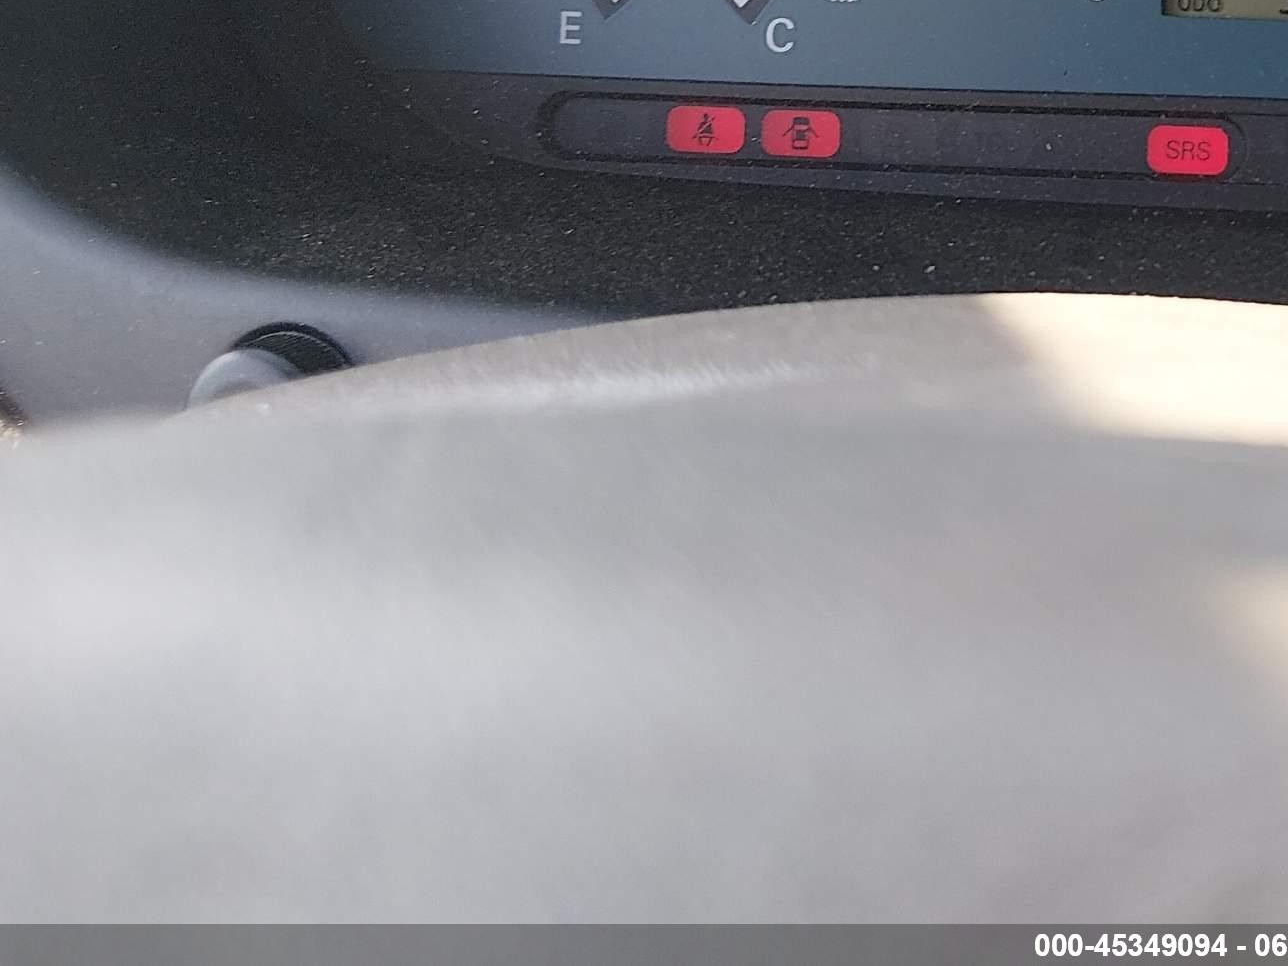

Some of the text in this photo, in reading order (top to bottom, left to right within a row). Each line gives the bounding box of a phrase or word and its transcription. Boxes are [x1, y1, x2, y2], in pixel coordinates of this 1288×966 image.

[560, 11, 581, 44] E
[767, 18, 794, 52] C
[1166, 140, 1210, 161] SRS
